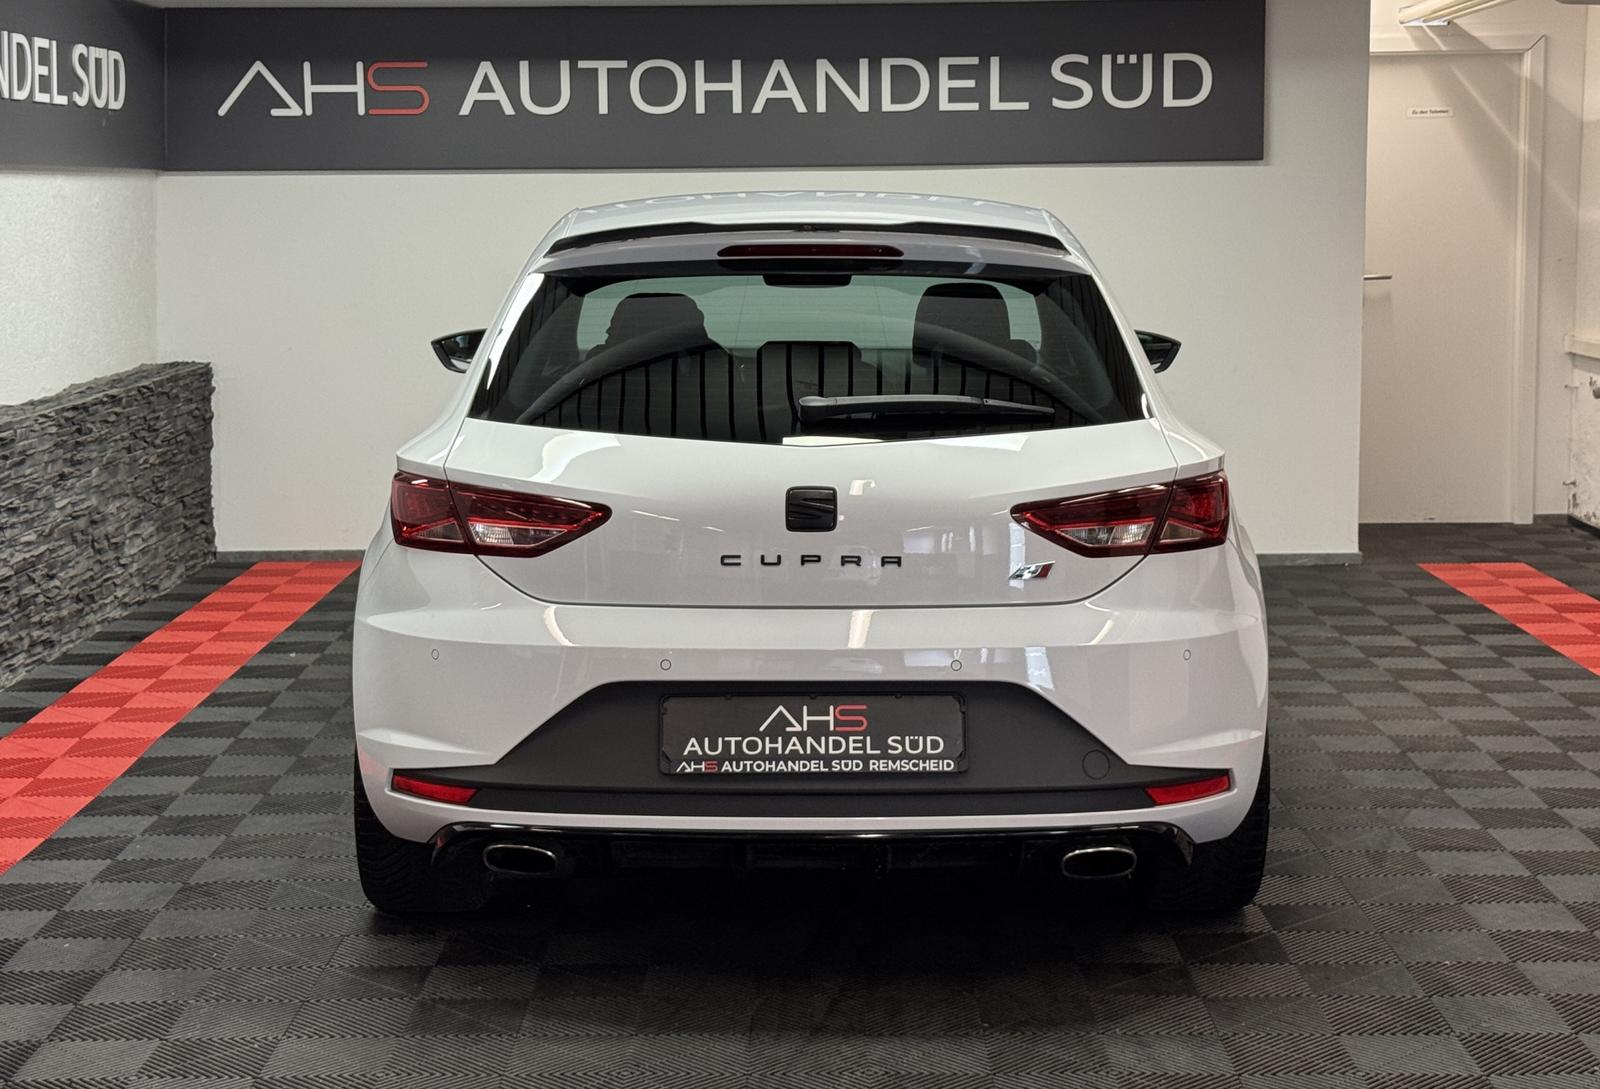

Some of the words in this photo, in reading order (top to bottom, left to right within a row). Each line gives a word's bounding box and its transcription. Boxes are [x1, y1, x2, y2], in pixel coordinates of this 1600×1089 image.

[72, 43, 126, 110] SÜD
[217, 60, 429, 117] AHS
[458, 56, 1030, 116] AUTOHANDEL
[1051, 53, 1213, 110] SÜD
[720, 554, 902, 568] CUPRA
[758, 704, 868, 732] AHS
[682, 735, 881, 756] AUTOHANDEL
[887, 735, 945, 755] SÜD
[675, 760, 718, 773] AHS
[720, 759, 829, 773] AUTOHANDEL
[831, 758, 864, 772] SÜD
[869, 758, 955, 772] REMSCHEID
